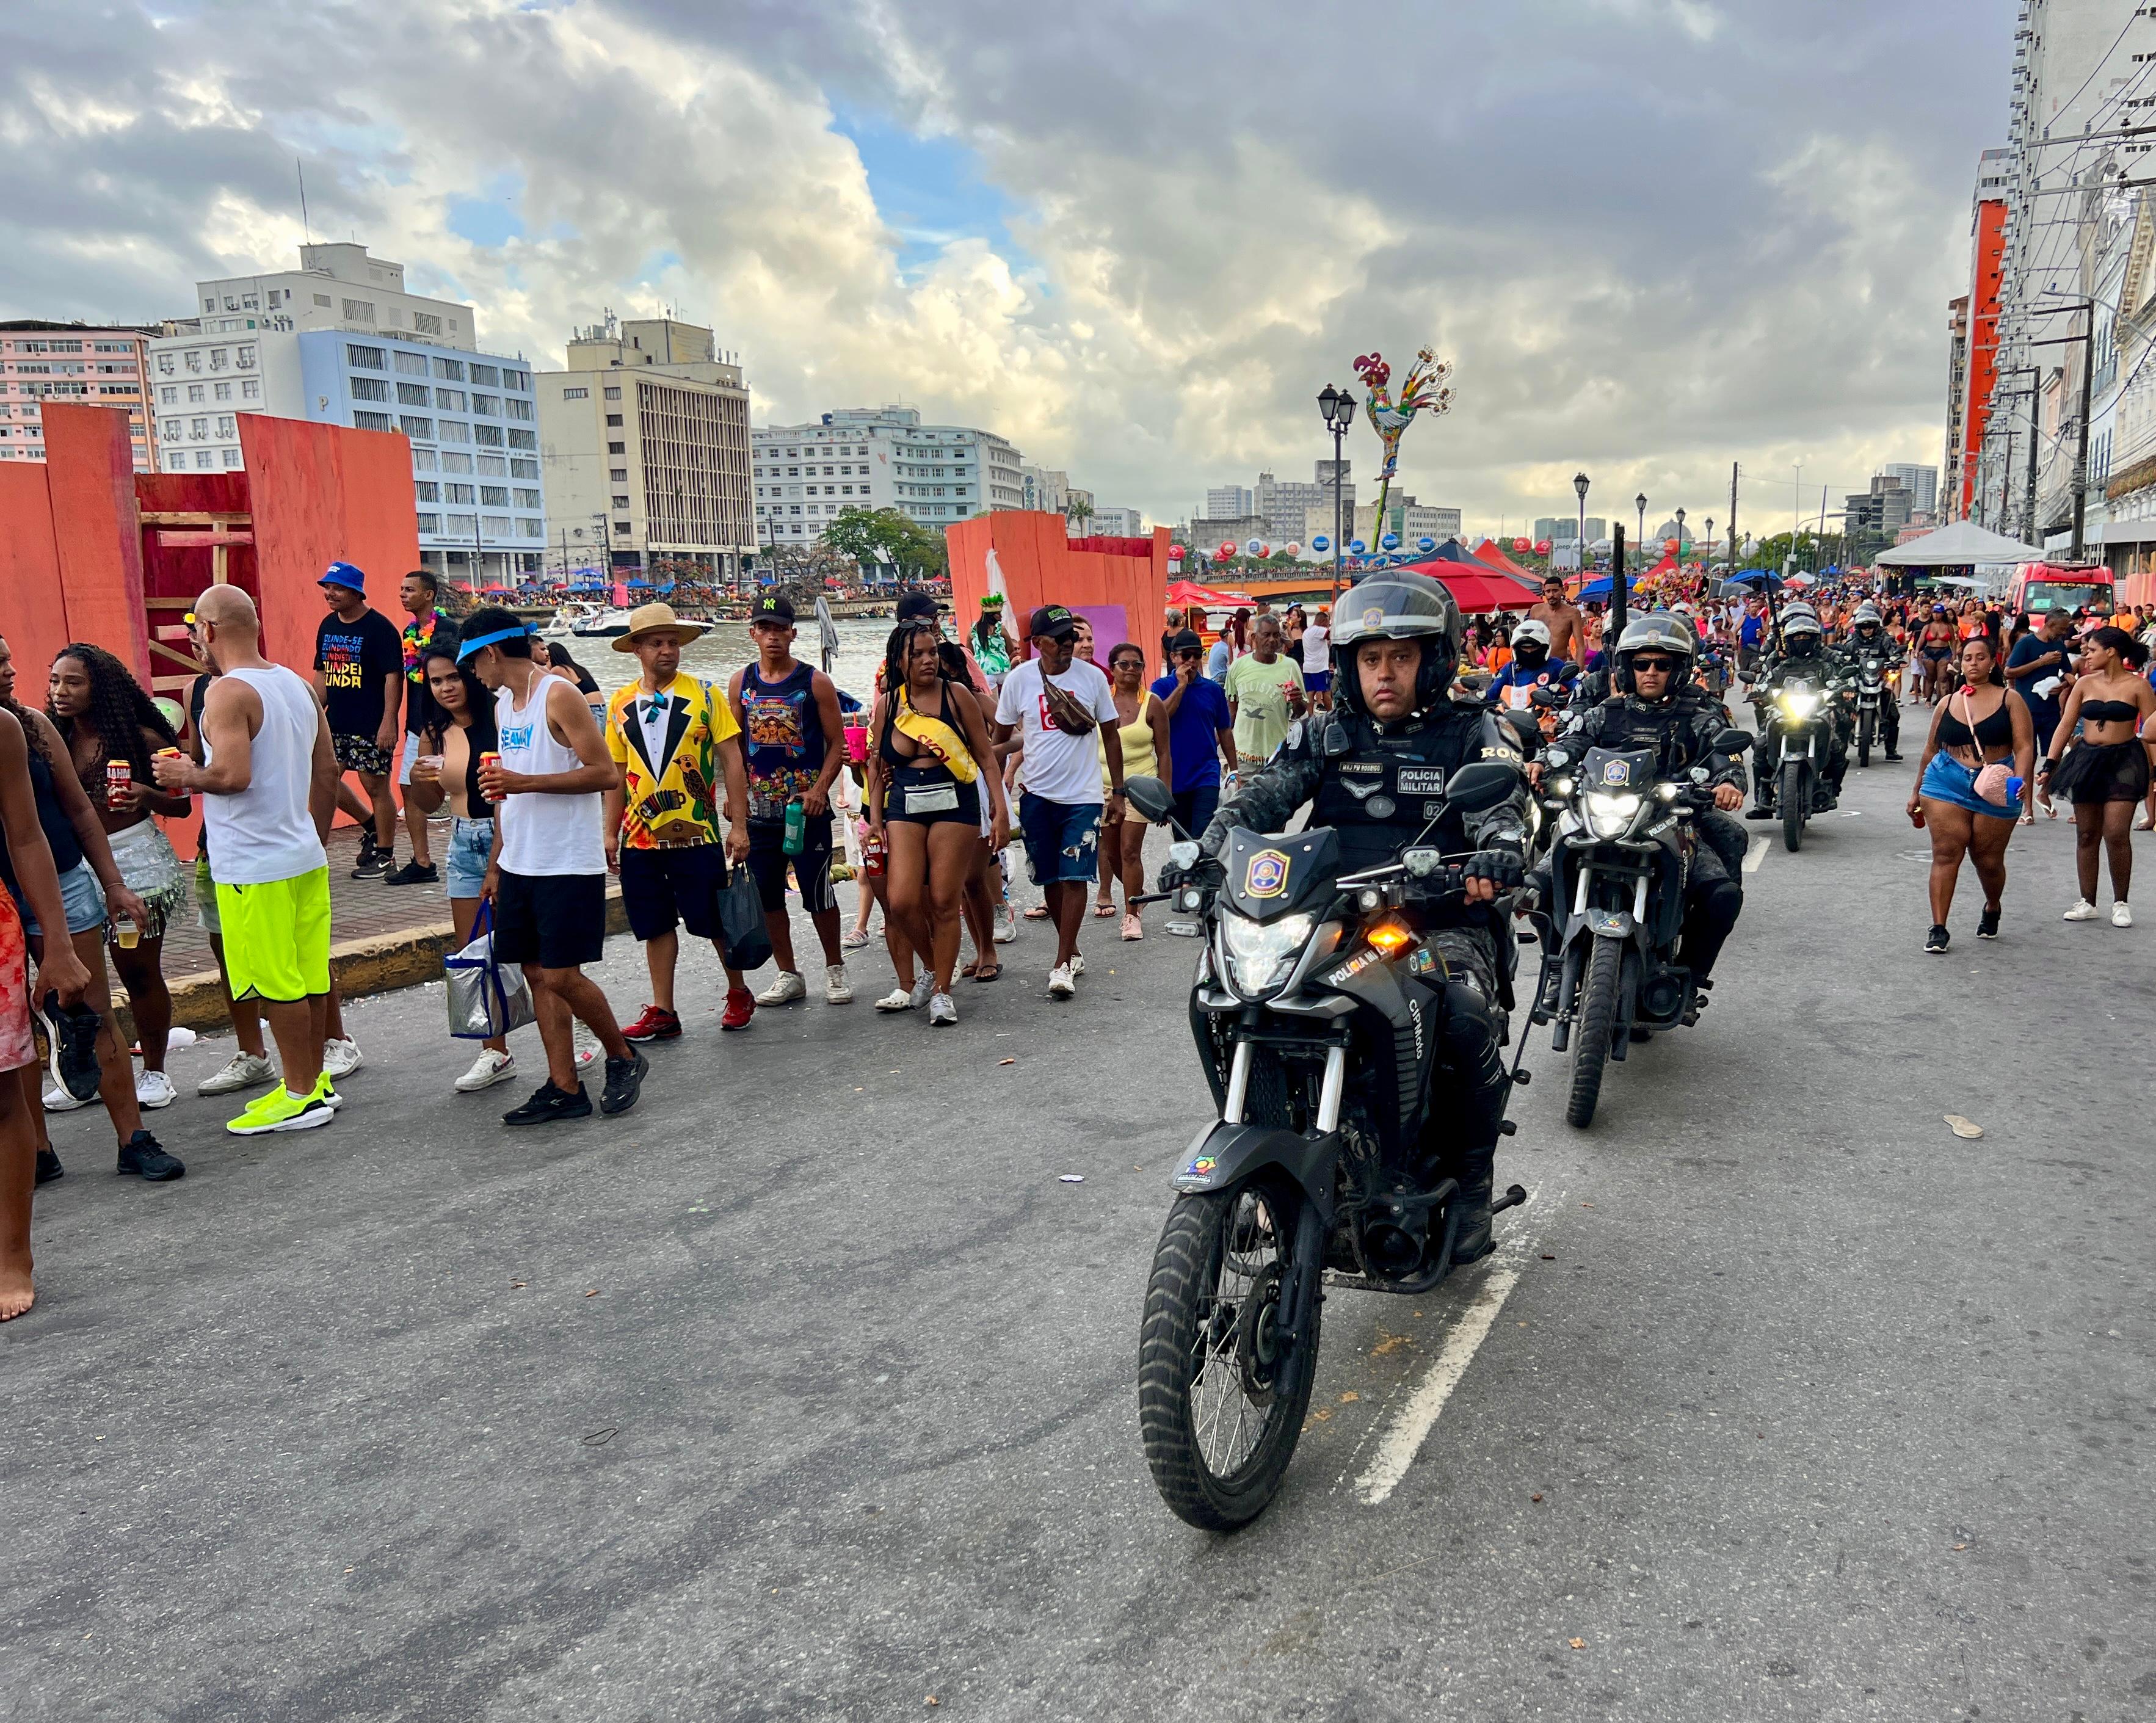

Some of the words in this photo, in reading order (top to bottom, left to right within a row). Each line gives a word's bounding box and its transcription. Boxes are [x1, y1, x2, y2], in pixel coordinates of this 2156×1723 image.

[763, 598, 776, 610] NY
[1400, 769, 1440, 781] POLÍCIA
[1400, 782, 1440, 792] MILITAR
[1426, 805, 1440, 817] 02
[1328, 956, 1369, 987] POLÍCIA
[1409, 999, 1424, 1059] CIPMoto
